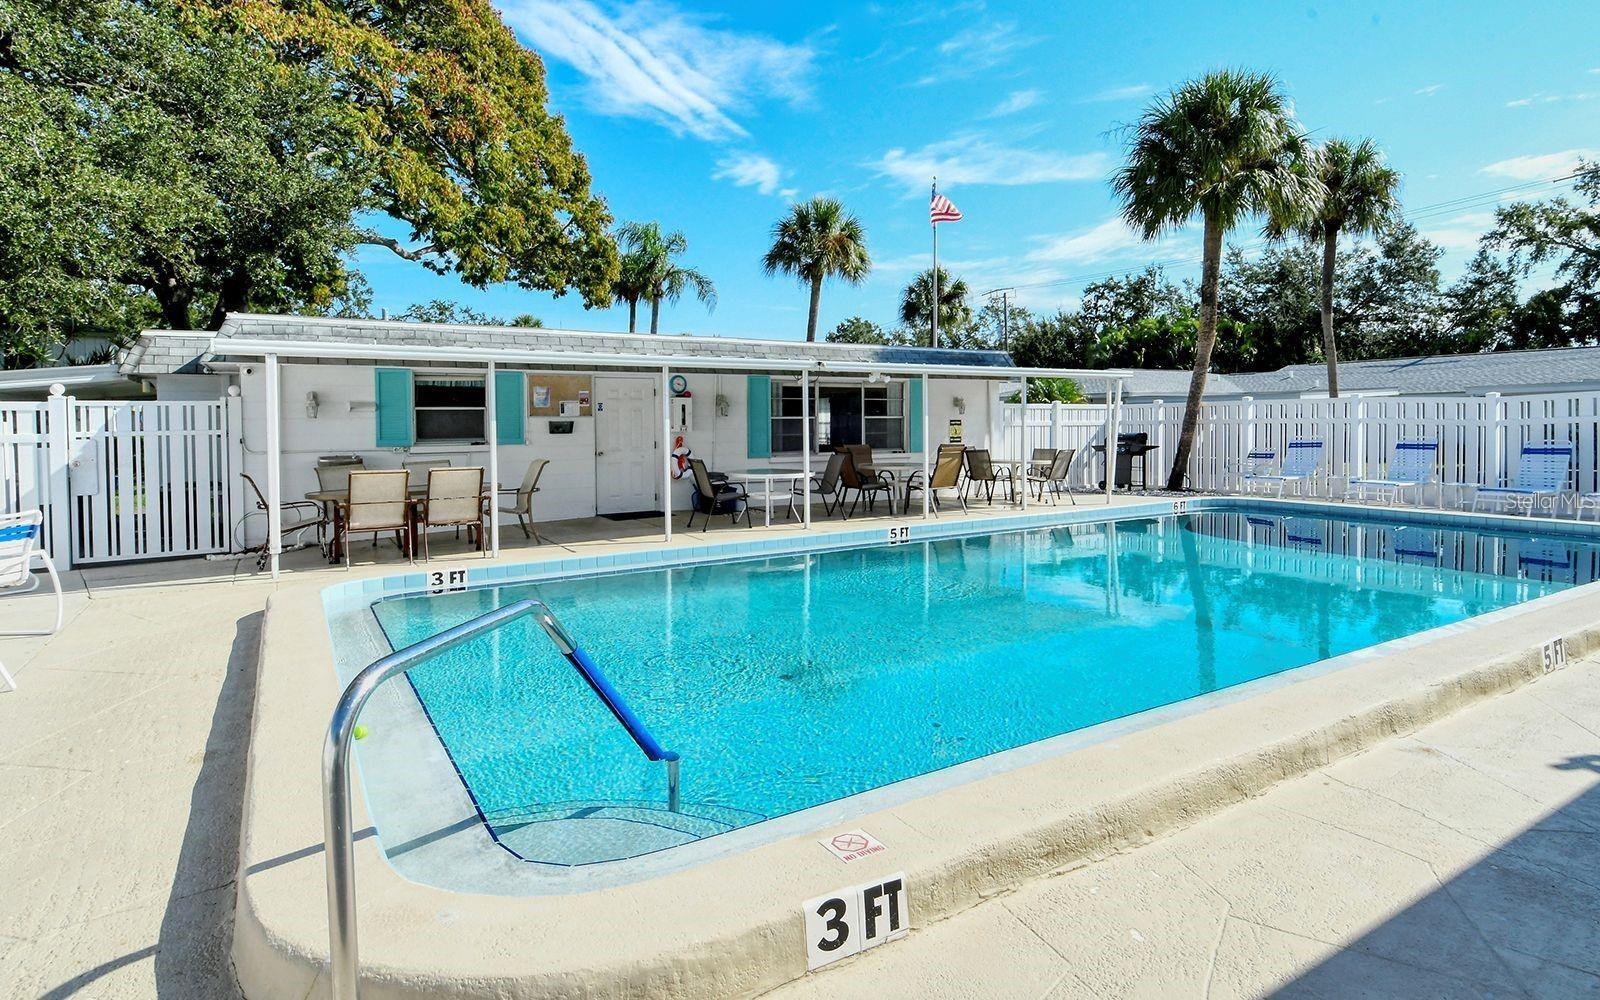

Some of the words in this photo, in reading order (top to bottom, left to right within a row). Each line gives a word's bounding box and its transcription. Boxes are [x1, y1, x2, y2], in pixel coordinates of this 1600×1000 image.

[890, 528, 897, 539] 5
[900, 526, 909, 538] FT
[431, 571, 444, 586] 3
[449, 570, 466, 584] FT
[1543, 644, 1551, 670] 5
[1553, 637, 1564, 665] FT
[843, 853, 857, 861] NO
[857, 845, 886, 857] DIVING
[816, 897, 850, 952] 3
[863, 878, 902, 940] FT
